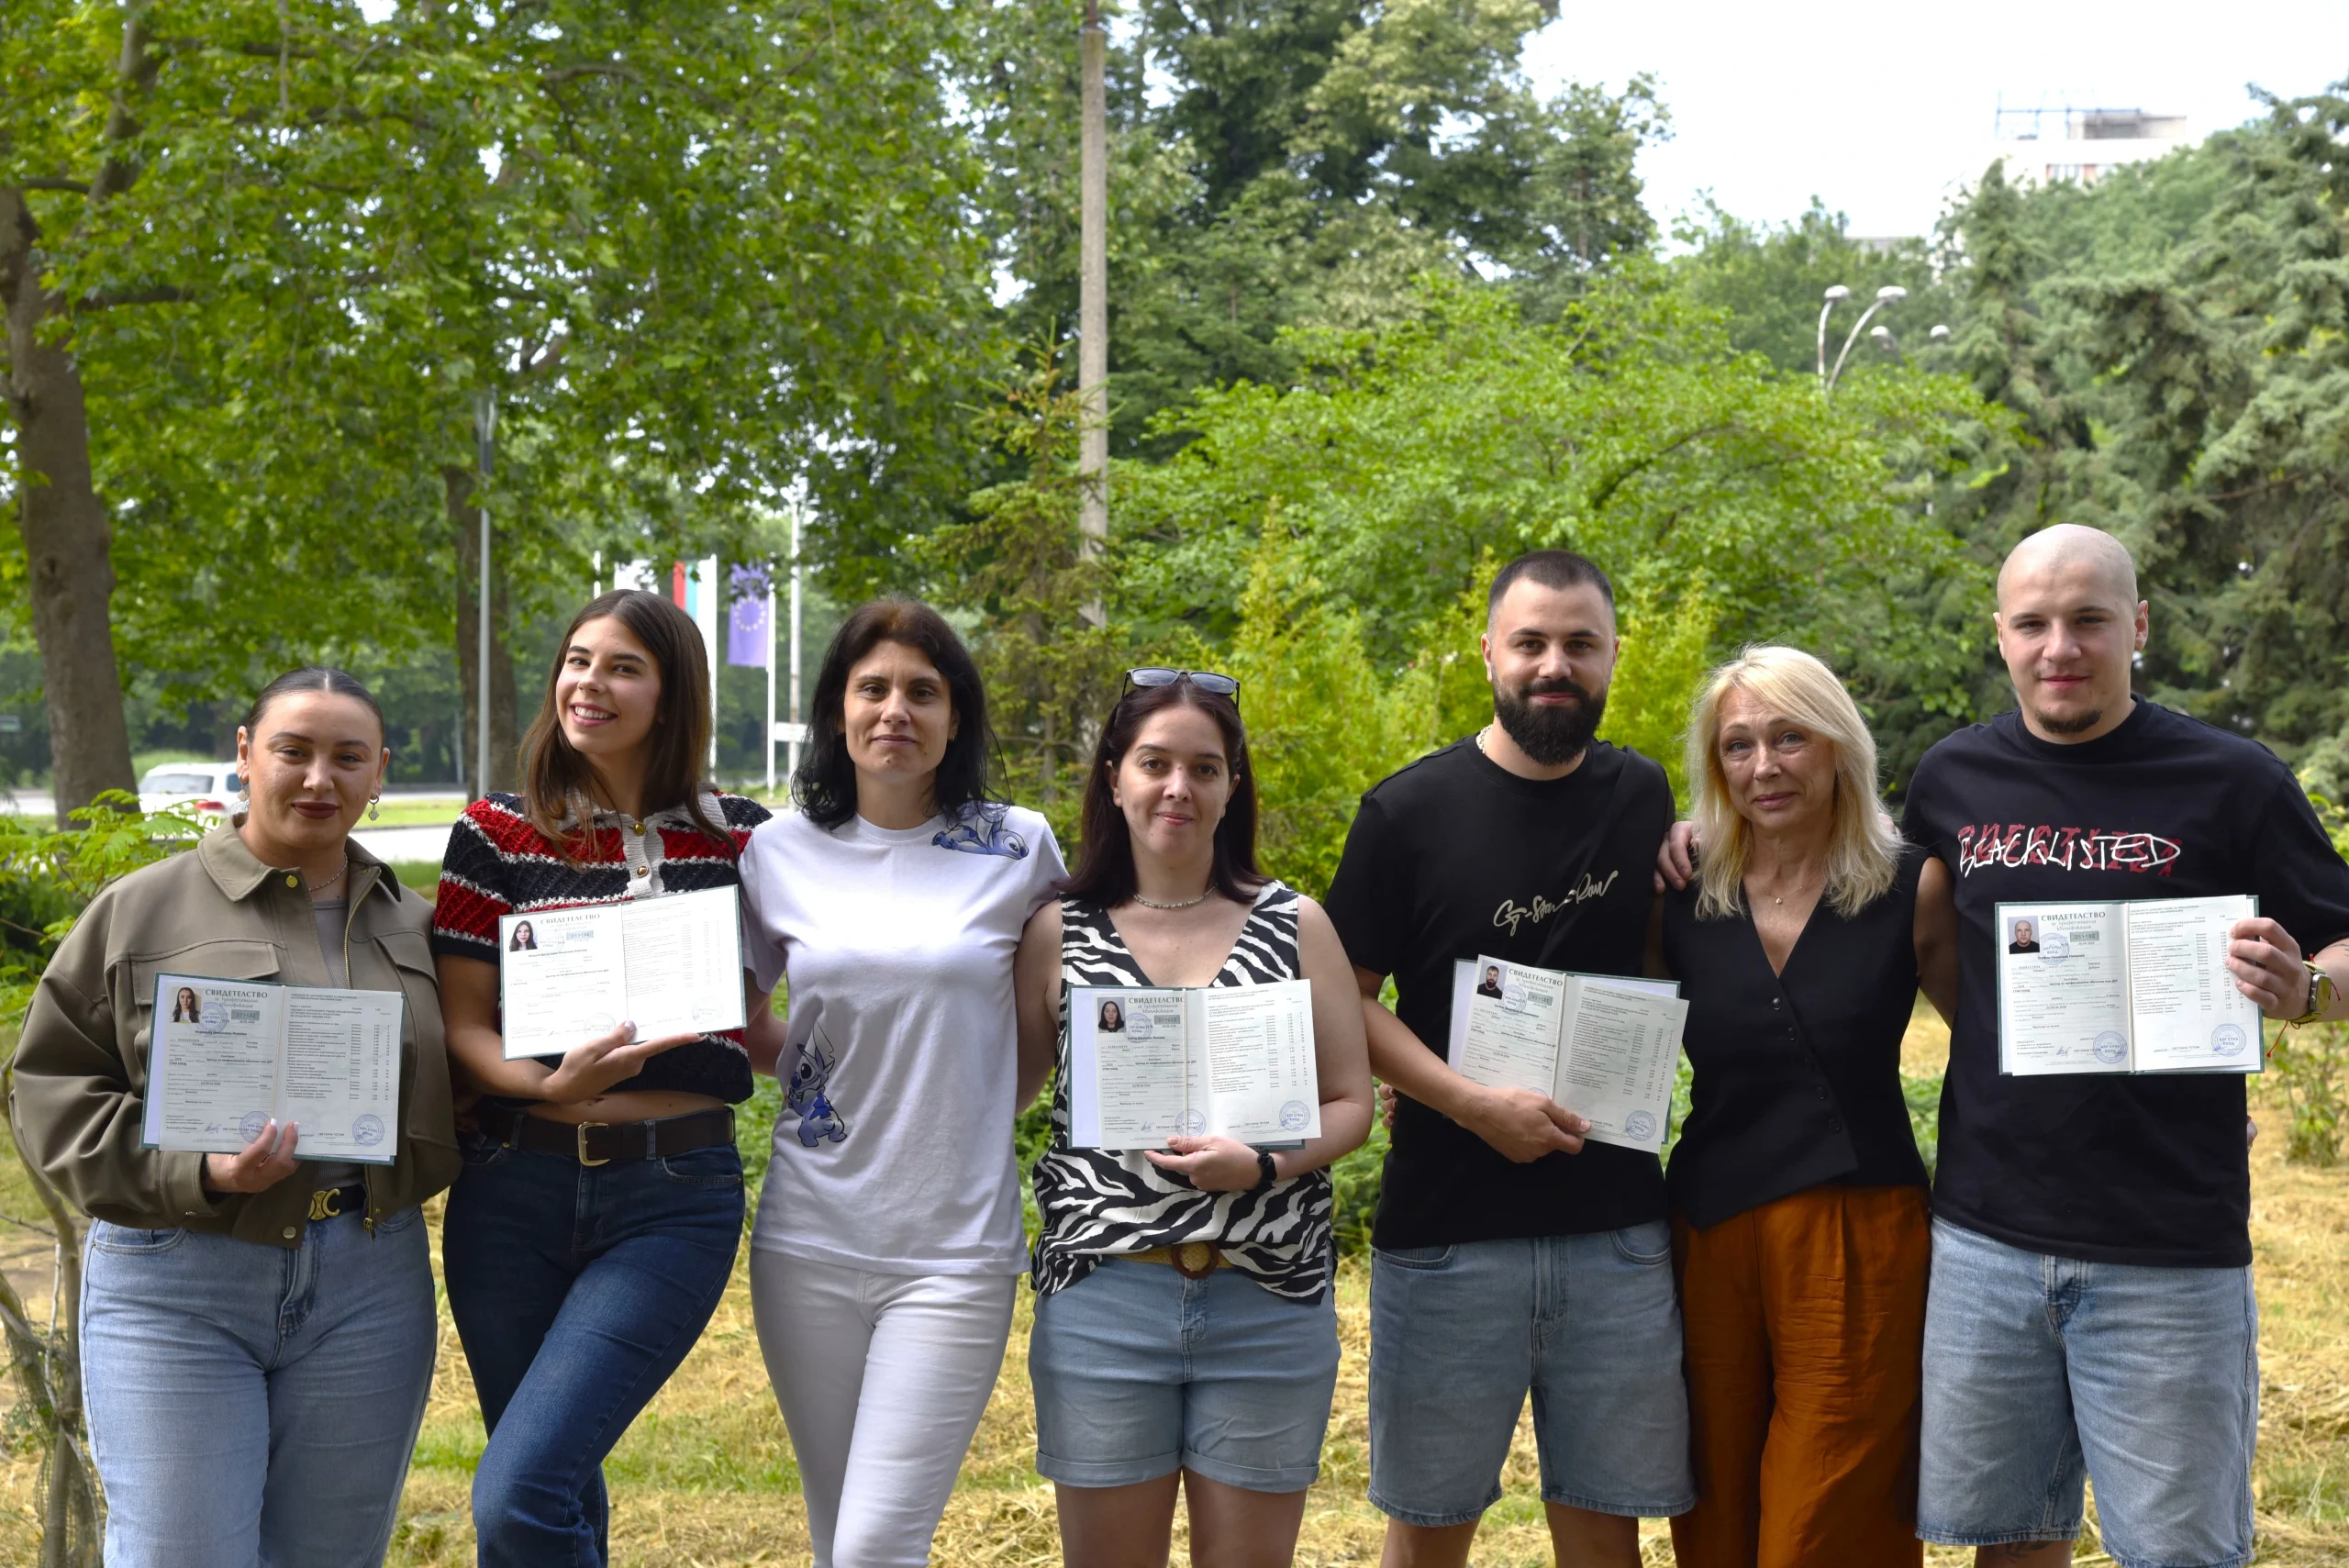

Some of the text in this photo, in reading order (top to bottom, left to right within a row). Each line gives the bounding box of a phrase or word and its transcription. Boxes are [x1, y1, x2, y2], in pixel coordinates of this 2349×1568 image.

[2041, 911, 2106, 921] СВИДЕТЕЛСТВО
[1508, 968, 1564, 987] СВИДЕТЕЛСТВО
[206, 988, 268, 999] СВИДЕТЕЛСТВО
